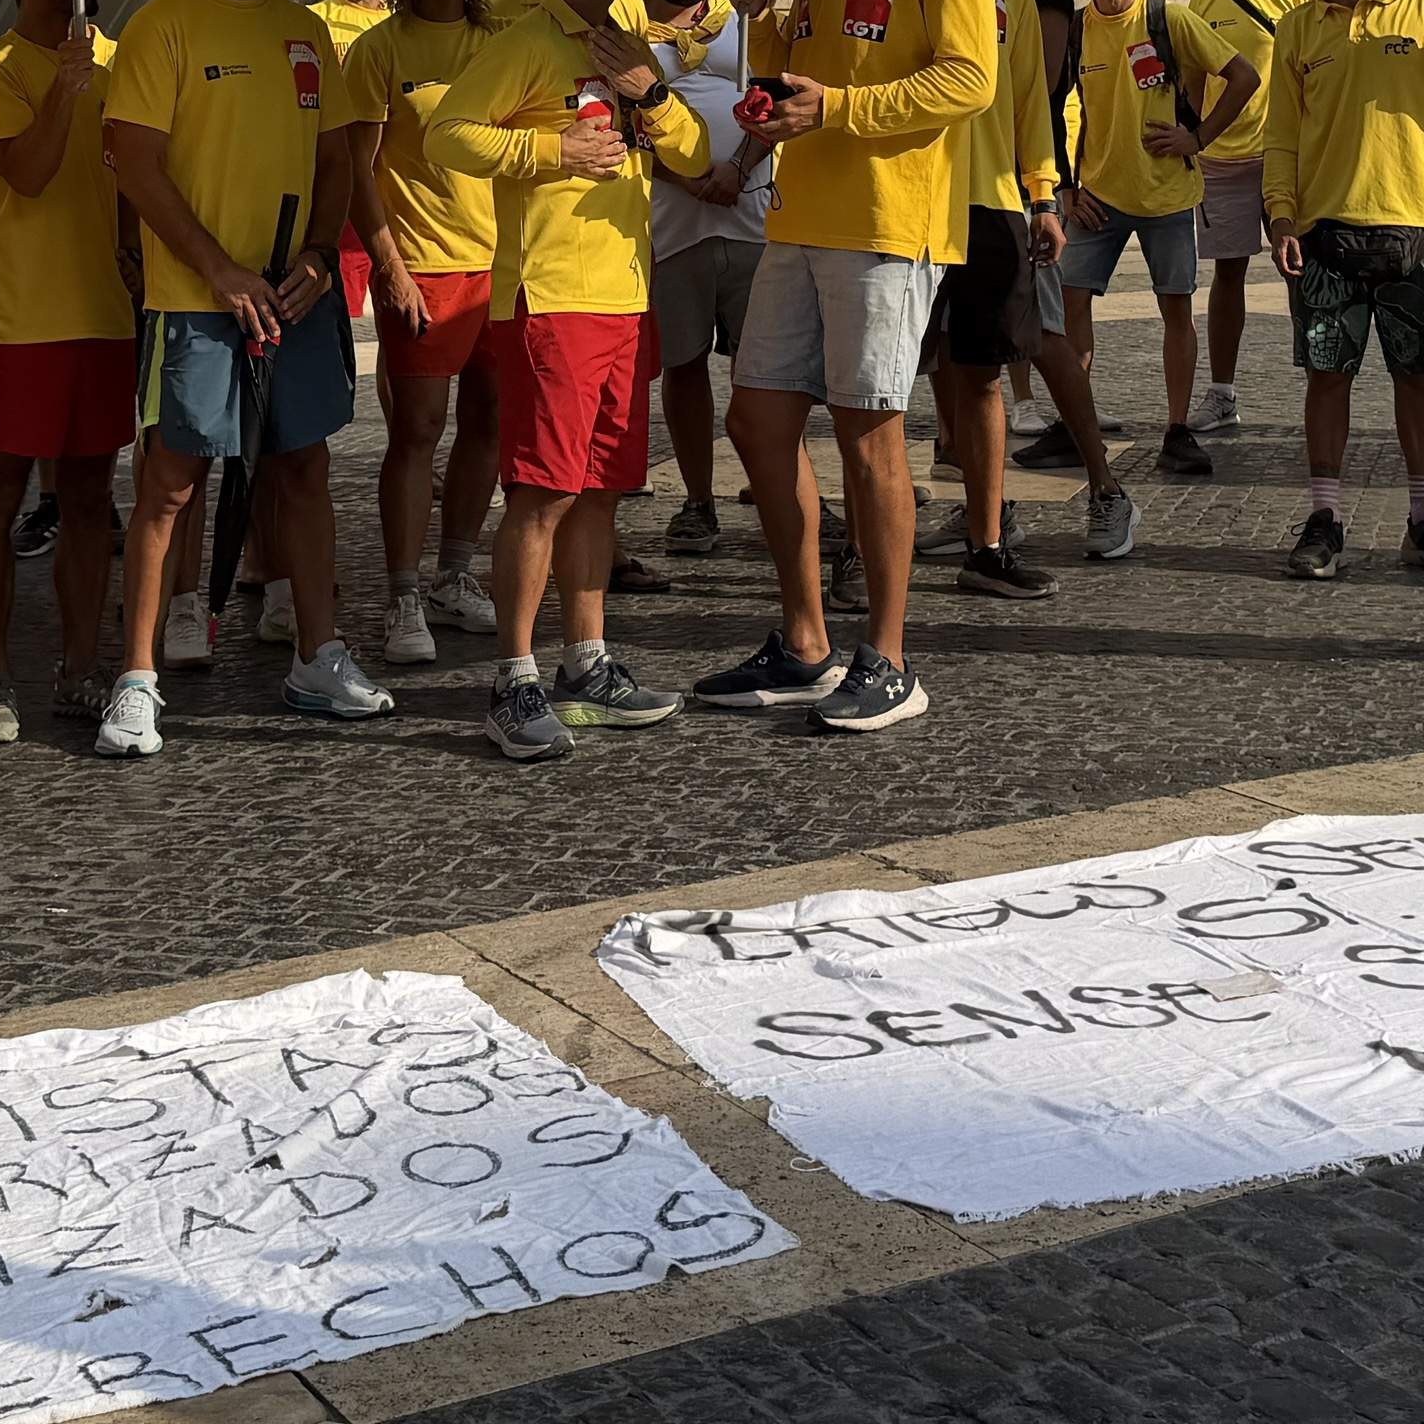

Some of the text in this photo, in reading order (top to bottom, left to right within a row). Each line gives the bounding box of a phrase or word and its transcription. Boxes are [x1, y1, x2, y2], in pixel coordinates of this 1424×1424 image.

[844, 18, 885, 38] CGT
[1138, 72, 1166, 89] CGT
[753, 980, 1272, 1062] SENSE
